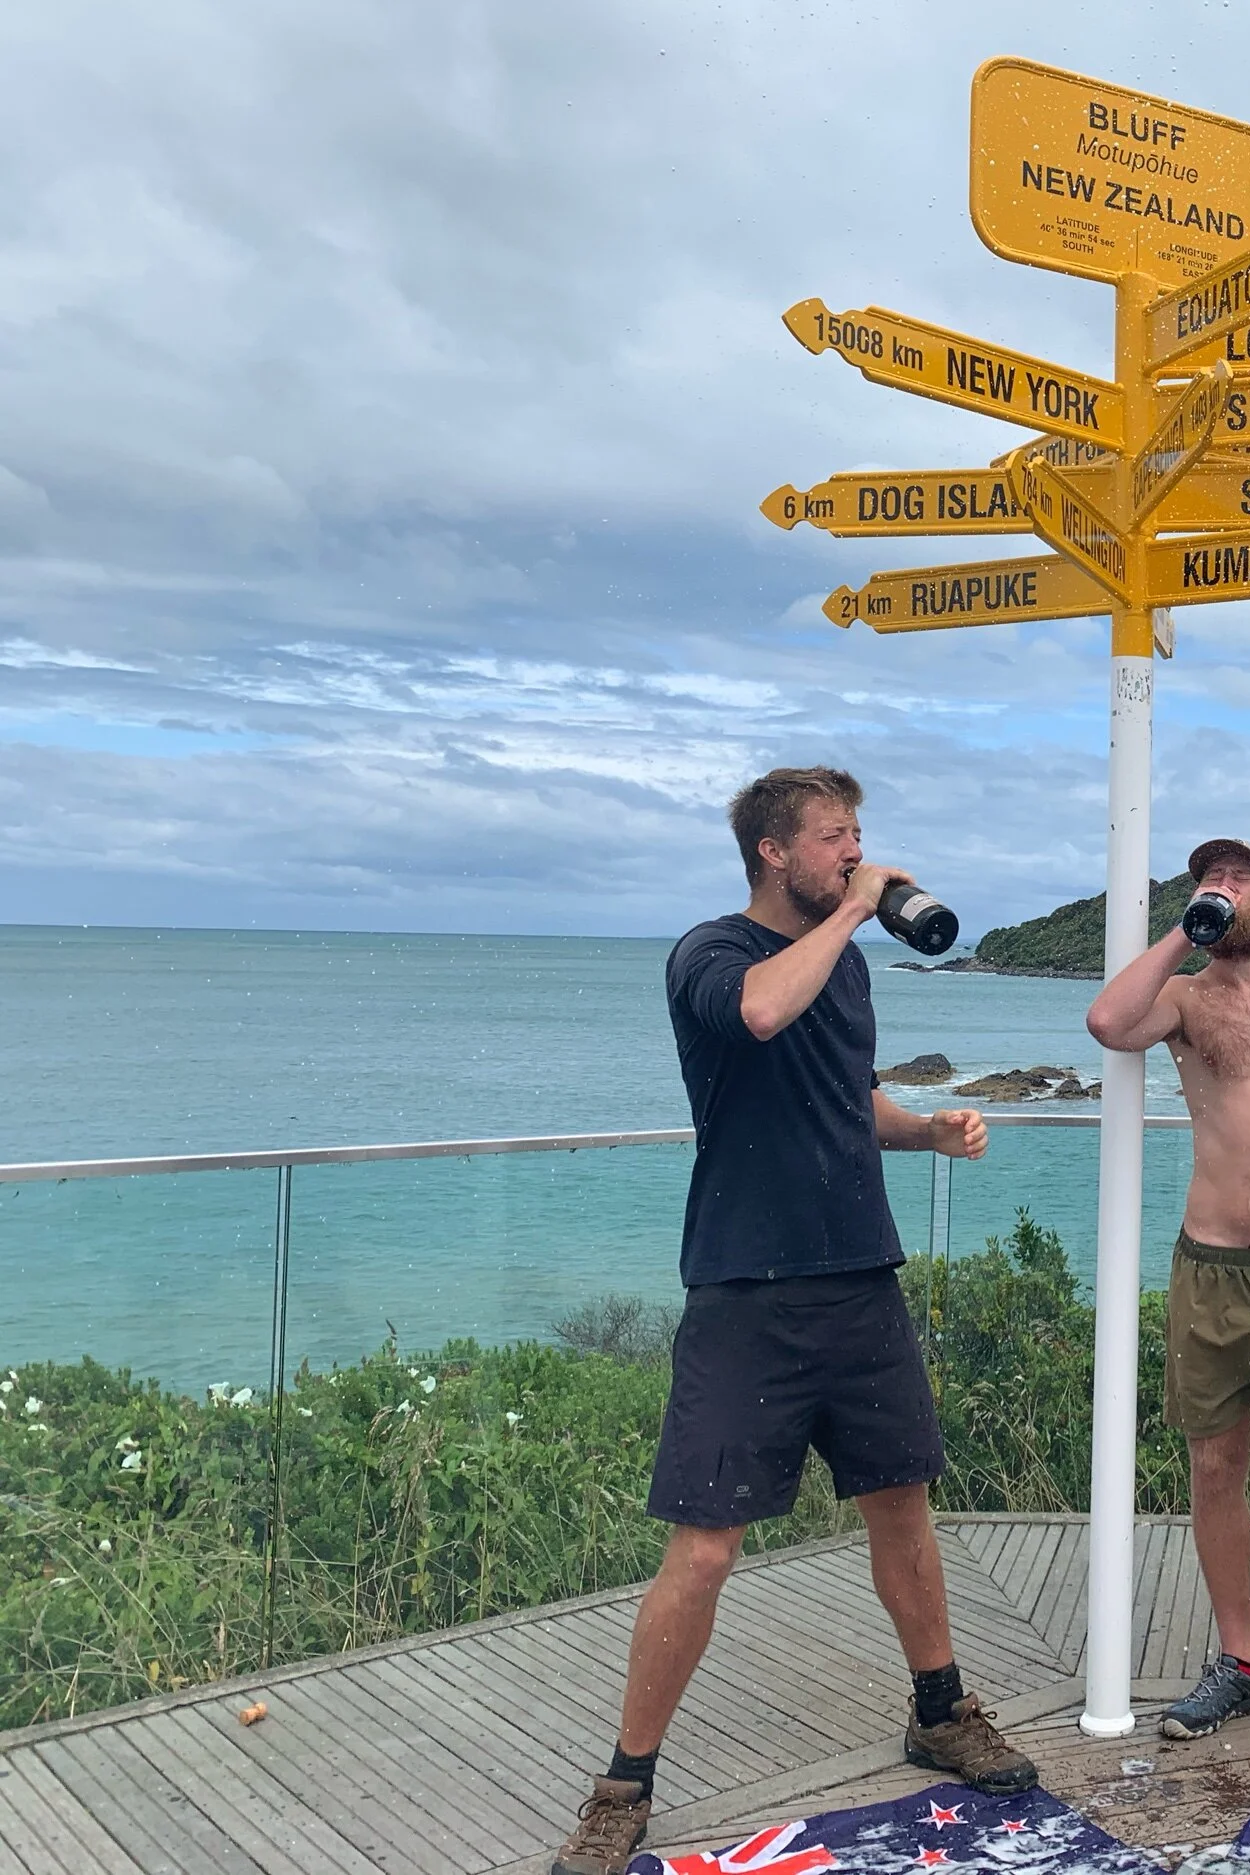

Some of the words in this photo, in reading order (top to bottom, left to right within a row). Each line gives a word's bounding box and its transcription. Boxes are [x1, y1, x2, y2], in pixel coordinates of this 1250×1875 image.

[1089, 101, 1187, 151] BLUFF
[1076, 132, 1199, 184] Motupōhue
[1021, 160, 1097, 203] NEW
[1104, 181, 1245, 240] ZEALAND
[1056, 215, 1100, 234] LATITUDE
[1056, 227, 1067, 237] 36
[1069, 231, 1086, 241] min
[1087, 233, 1098, 244] 54
[1099, 238, 1115, 248] sec
[1062, 240, 1094, 255] SOUTH
[1169, 243, 1218, 263] LONGITUDE
[1176, 255, 1186, 265] 21
[1182, 268, 1205, 279] EAS
[813, 312, 884, 359] 15008
[892, 335, 924, 371] km
[947, 347, 1015, 404] NEW
[1025, 371, 1100, 430] YORK
[784, 498, 796, 520] 6
[804, 495, 835, 518] km
[859, 485, 925, 522] DOG
[938, 483, 1030, 520] ISLA
[1021, 465, 1038, 506] 784
[1040, 482, 1053, 520] km
[1061, 494, 1126, 585] WELLINGTON
[841, 595, 860, 618] 21
[867, 593, 892, 616] km
[911, 572, 1038, 617] RUAPUKE
